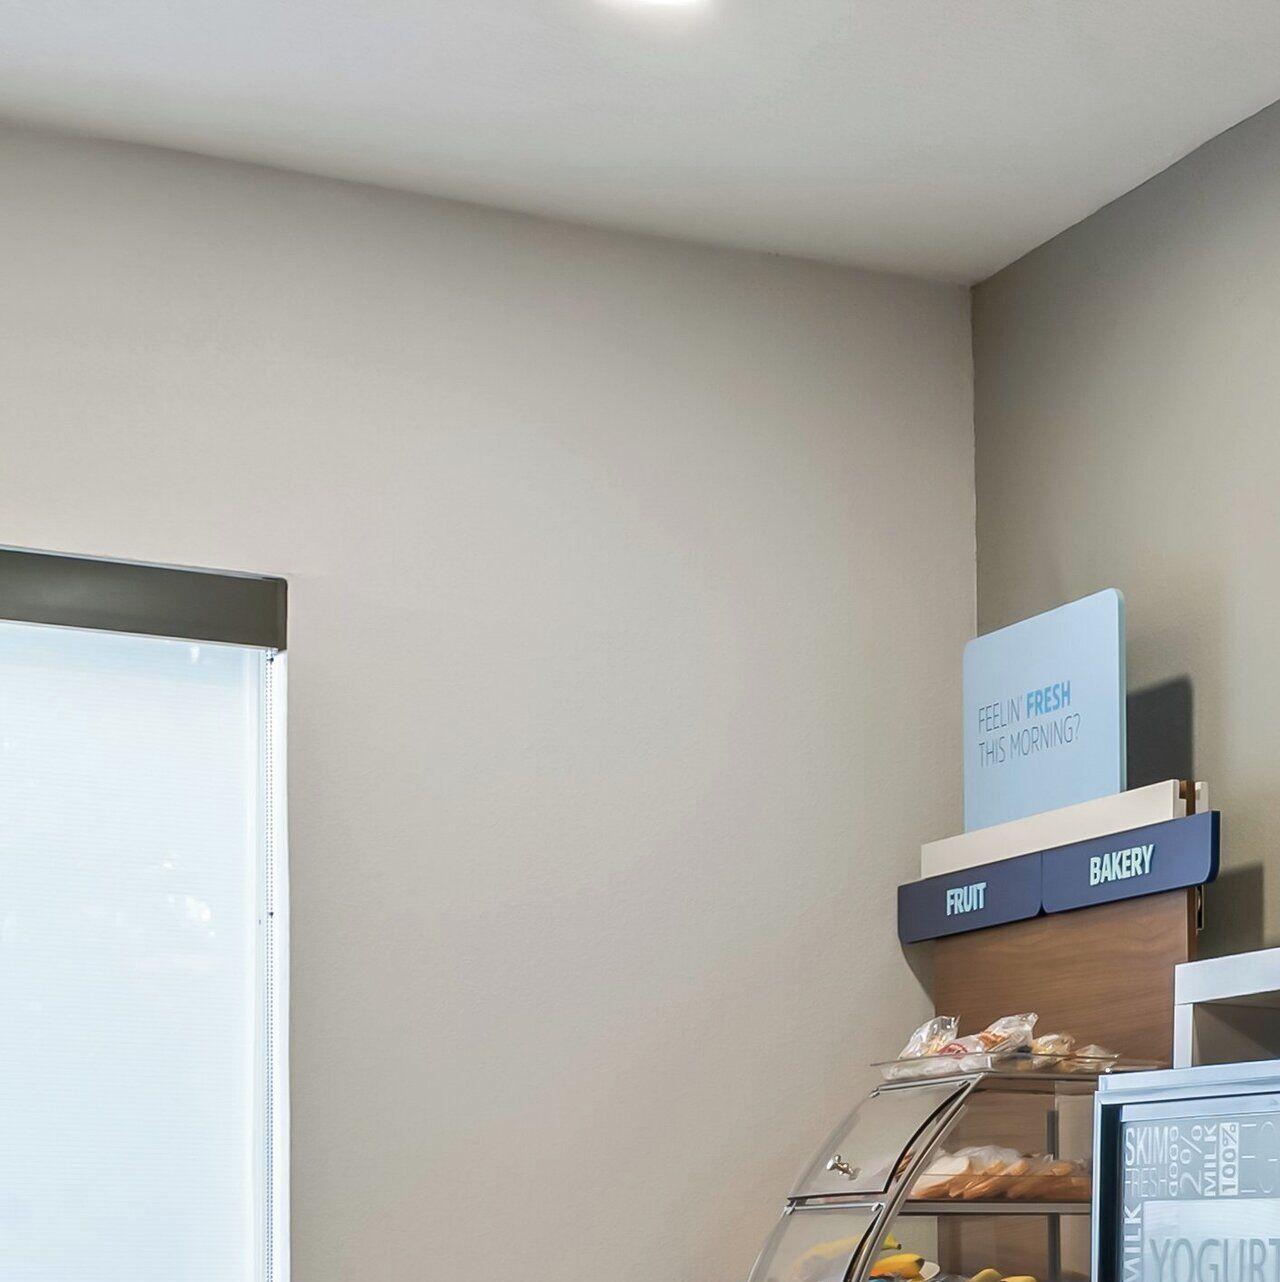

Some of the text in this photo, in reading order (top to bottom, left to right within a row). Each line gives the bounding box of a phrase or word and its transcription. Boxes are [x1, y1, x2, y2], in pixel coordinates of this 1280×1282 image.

[1026, 680, 1071, 720] FRESH
[978, 712, 1082, 768] THIS MORNING?
[1089, 843, 1156, 887] BAKERY
[945, 880, 989, 917] FRUIT
[1125, 1126, 1169, 1166] SKIM
[1204, 1123, 1218, 1197] MILK
[1221, 1123, 1238, 1192] 100%
